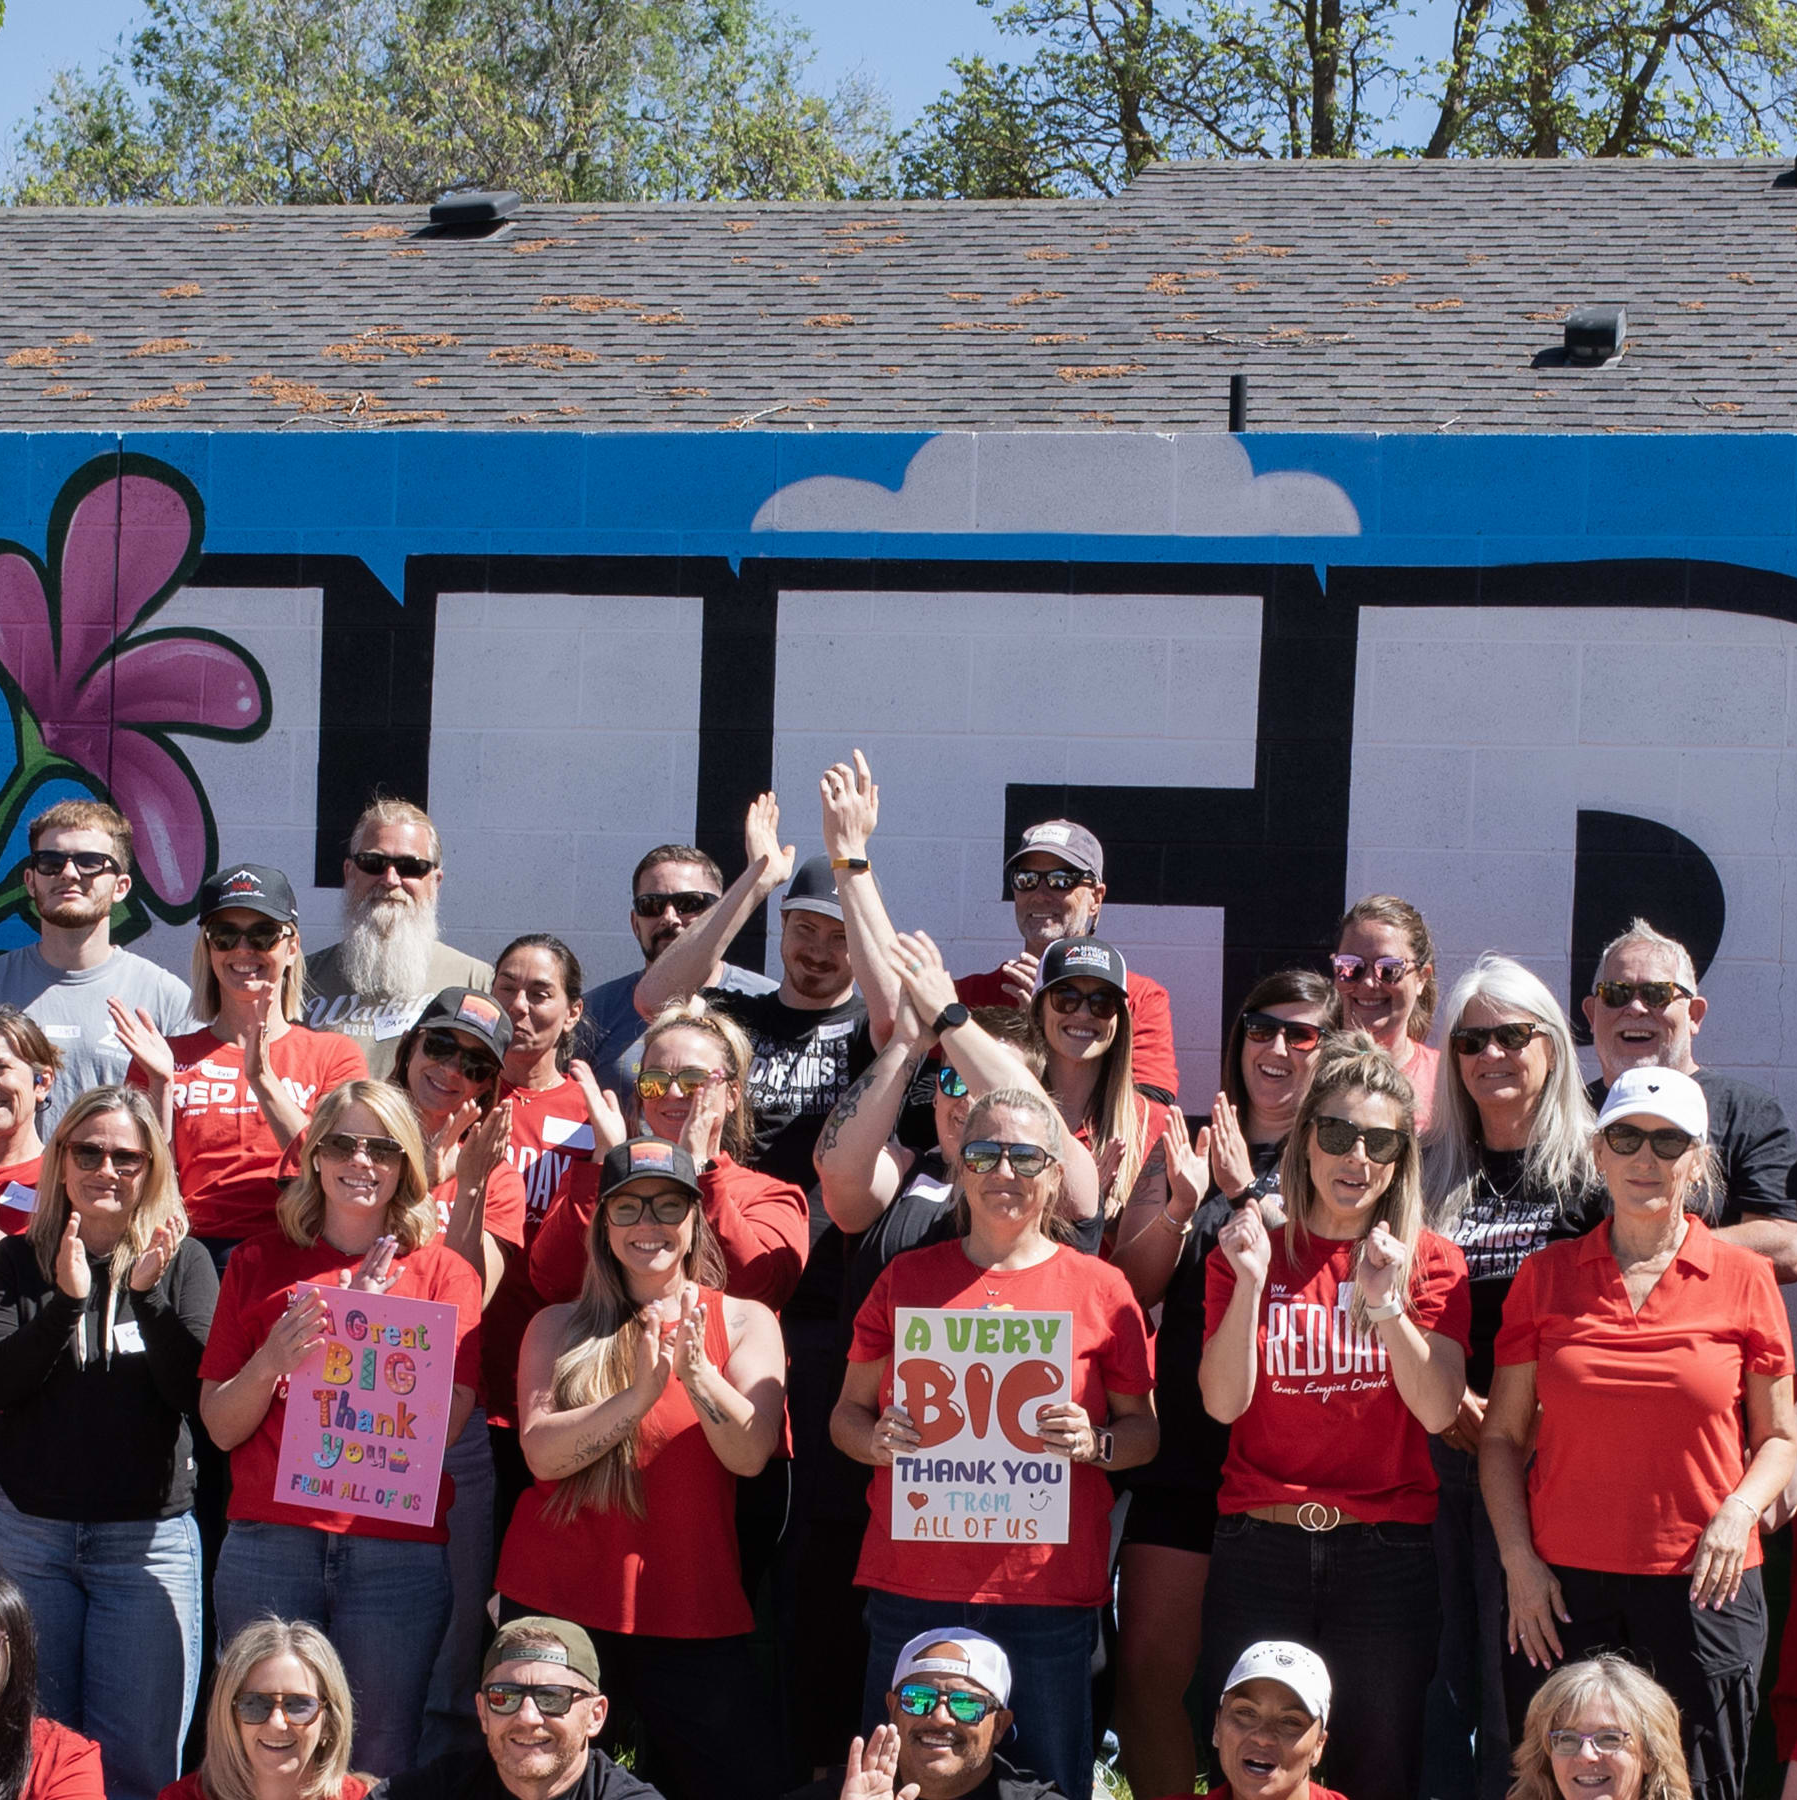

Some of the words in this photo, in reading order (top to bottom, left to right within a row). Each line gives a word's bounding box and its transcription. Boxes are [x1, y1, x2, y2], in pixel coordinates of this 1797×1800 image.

[173, 1081, 237, 1108] RED
[1455, 1220, 1537, 1249] EAMS
[1271, 1282, 1287, 1293] kw
[318, 1309, 337, 1336] A
[345, 1309, 431, 1351] Great
[904, 1316, 932, 1352] A
[943, 1317, 1061, 1354] VERY
[1266, 1302, 1327, 1376] RED
[322, 1341, 416, 1396] BIG
[312, 1389, 418, 1440] Thank
[897, 1358, 1064, 1455] BIG
[312, 1432, 387, 1470] you
[896, 1456, 996, 1485] THANK
[1002, 1459, 1062, 1485] YOU
[291, 1473, 333, 1497] FROM
[339, 1482, 370, 1503] ALL
[375, 1488, 398, 1508] OF
[403, 1494, 422, 1512] US
[913, 1516, 954, 1538] ALL
[964, 1517, 998, 1540] OF
[1006, 1518, 1038, 1540] US
